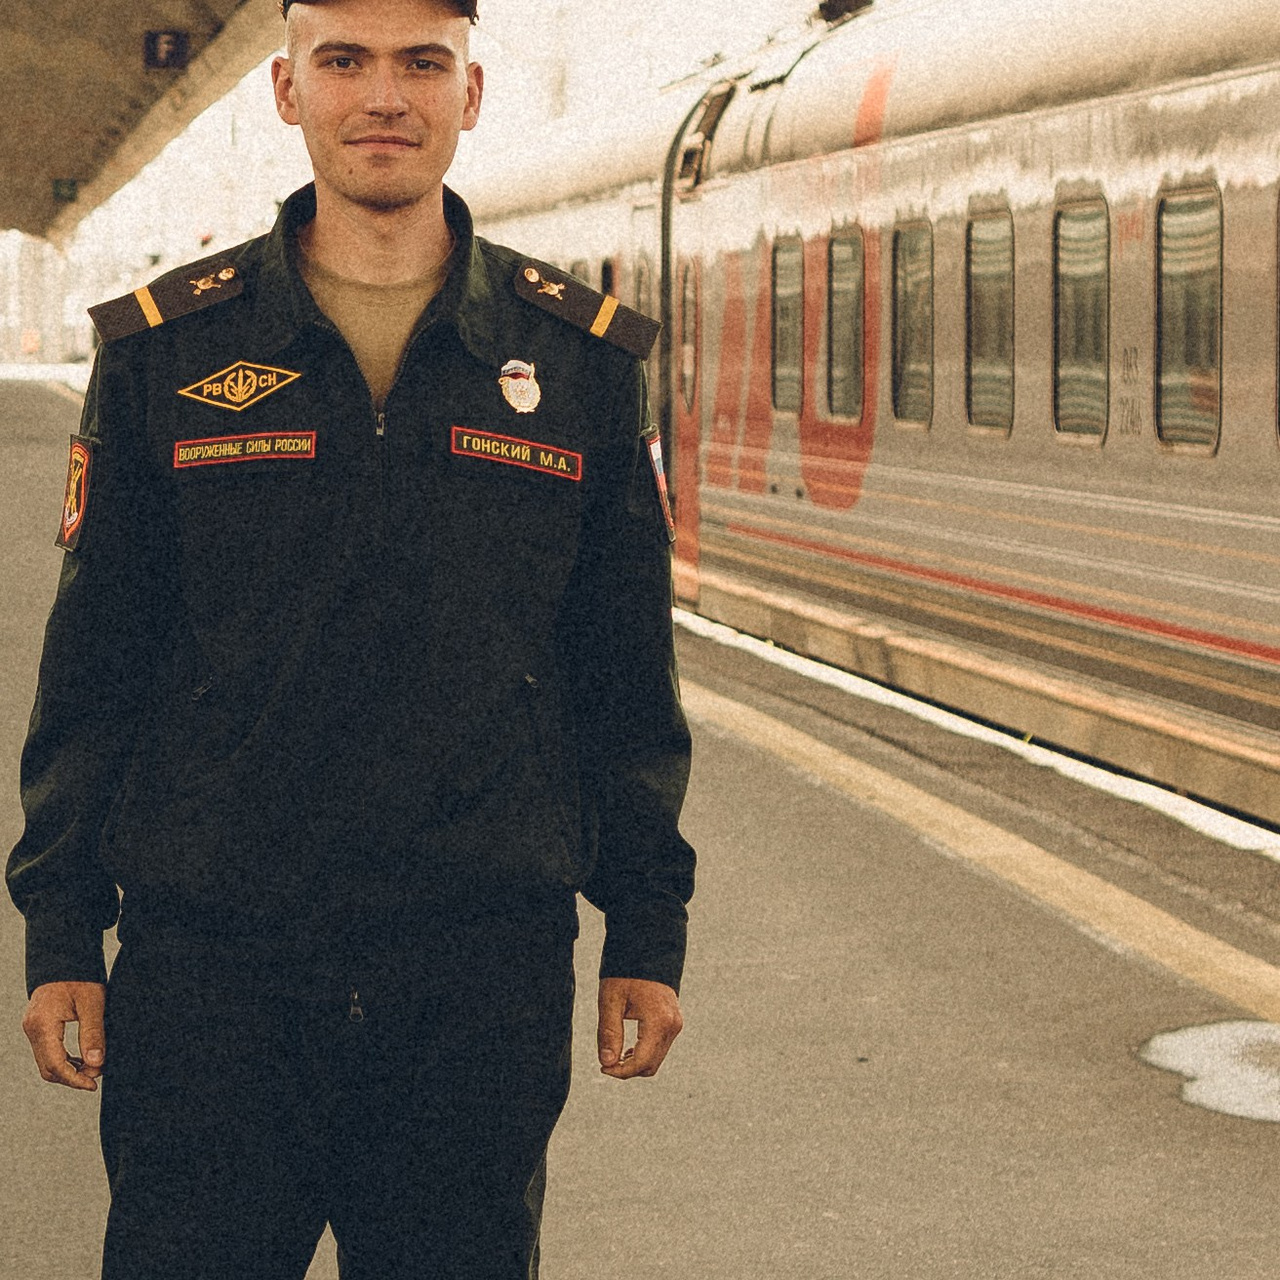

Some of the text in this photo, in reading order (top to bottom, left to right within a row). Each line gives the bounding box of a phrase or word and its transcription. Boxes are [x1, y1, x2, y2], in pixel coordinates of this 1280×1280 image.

[203, 372, 277, 397] РВ СН
[178, 438, 311, 461] ВООРУЖЕННЫЕ СИЛЫ РОССИИ
[462, 435, 571, 472] ГОНСКИЙ М.А.
